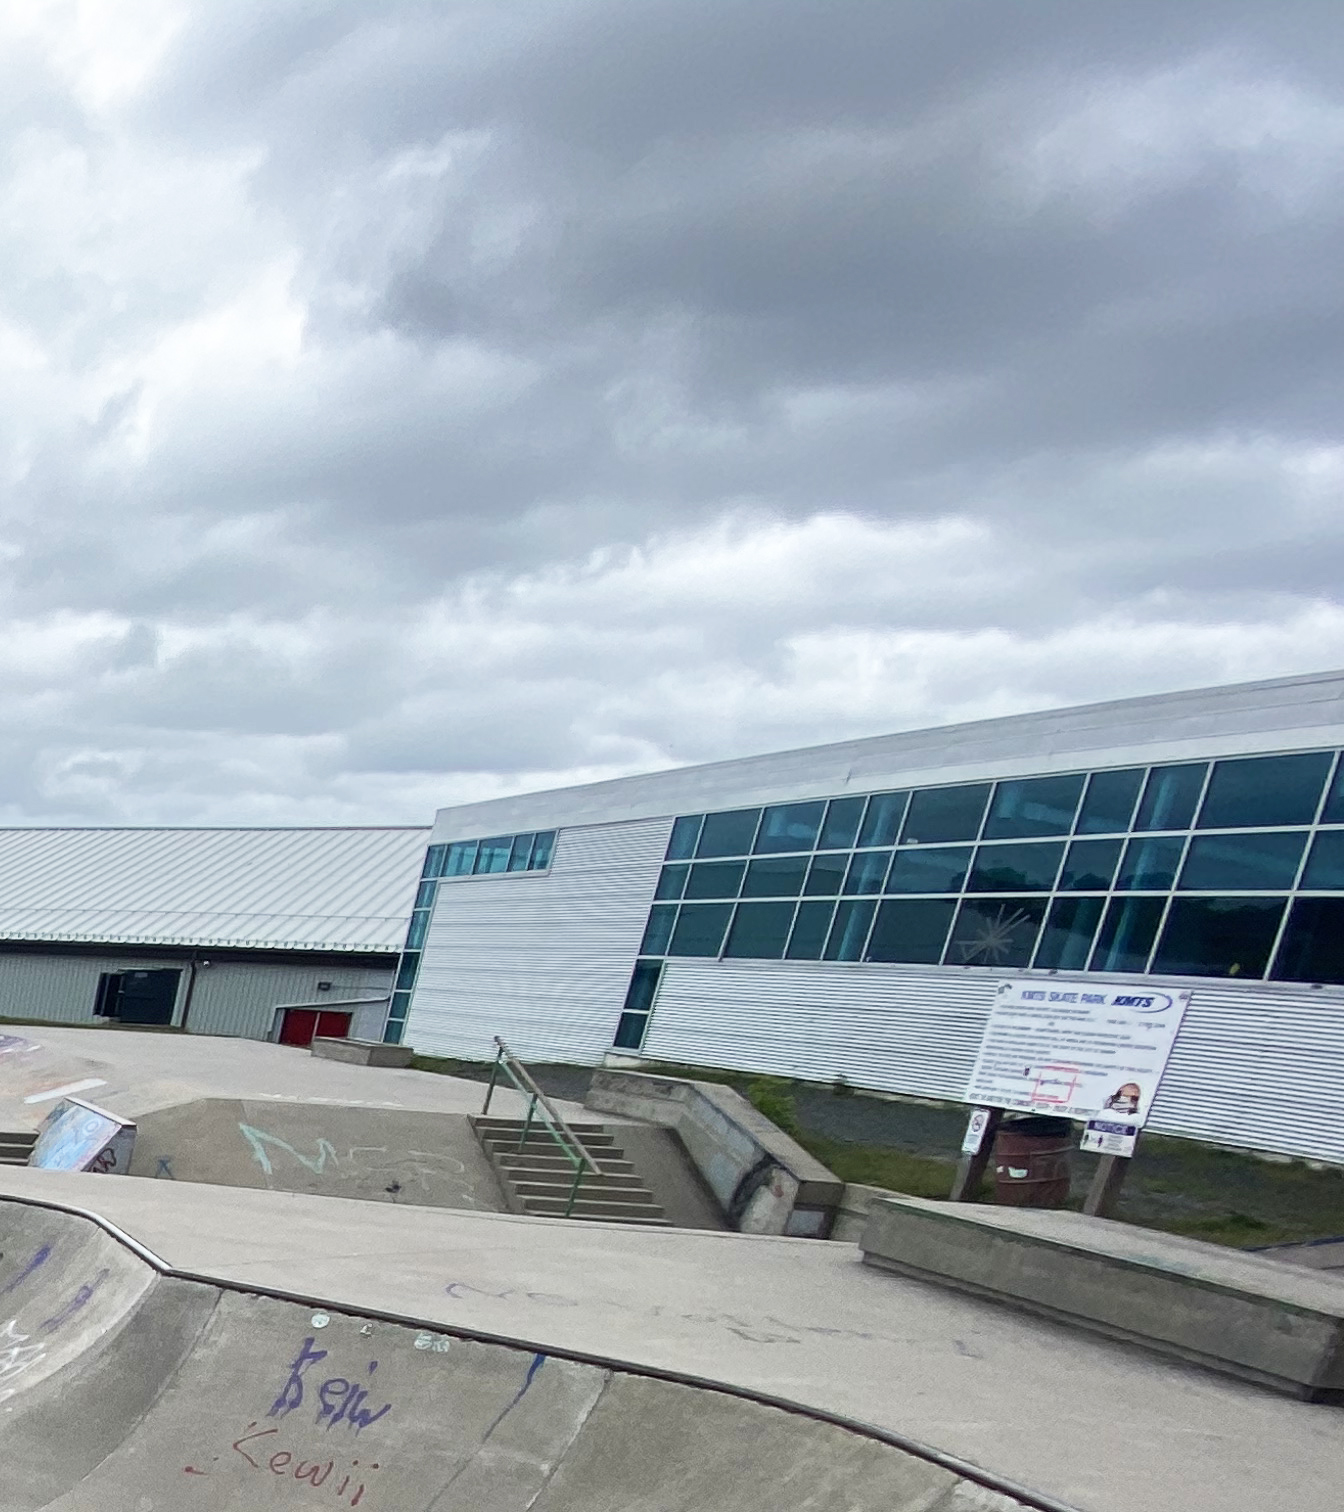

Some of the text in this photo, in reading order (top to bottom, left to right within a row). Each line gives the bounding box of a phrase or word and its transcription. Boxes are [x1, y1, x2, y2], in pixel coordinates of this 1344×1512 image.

[1048, 991, 1079, 1004] SKATE
[1080, 993, 1108, 1005] PARK
[1111, 995, 1156, 1008] KMTS
